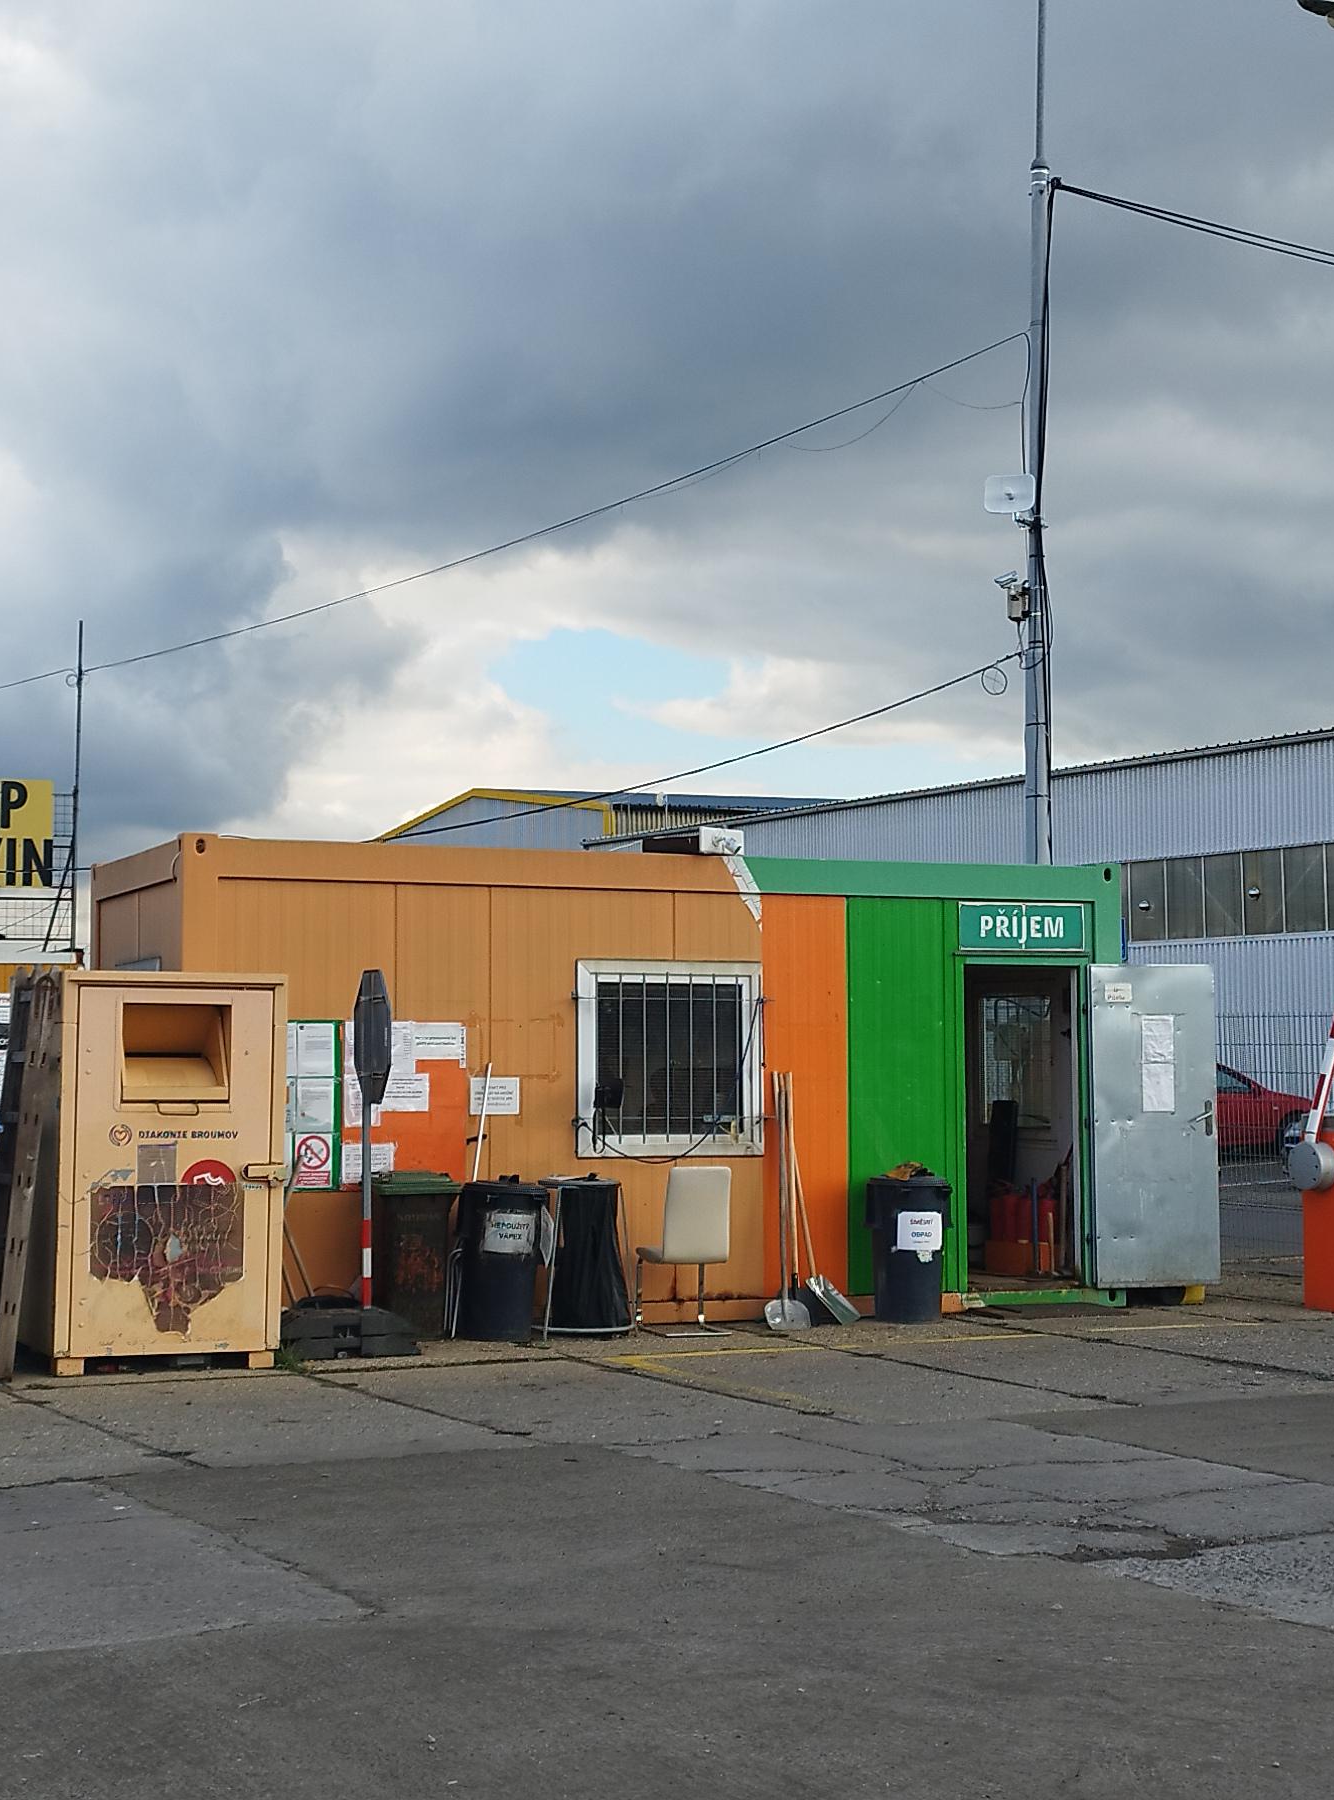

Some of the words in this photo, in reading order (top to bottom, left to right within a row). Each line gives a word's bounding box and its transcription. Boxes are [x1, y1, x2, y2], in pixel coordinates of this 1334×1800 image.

[979, 908, 1064, 944] PŘÍJEM
[138, 1130, 188, 1139] DIAKONIE
[191, 1130, 239, 1139] BROUMOV
